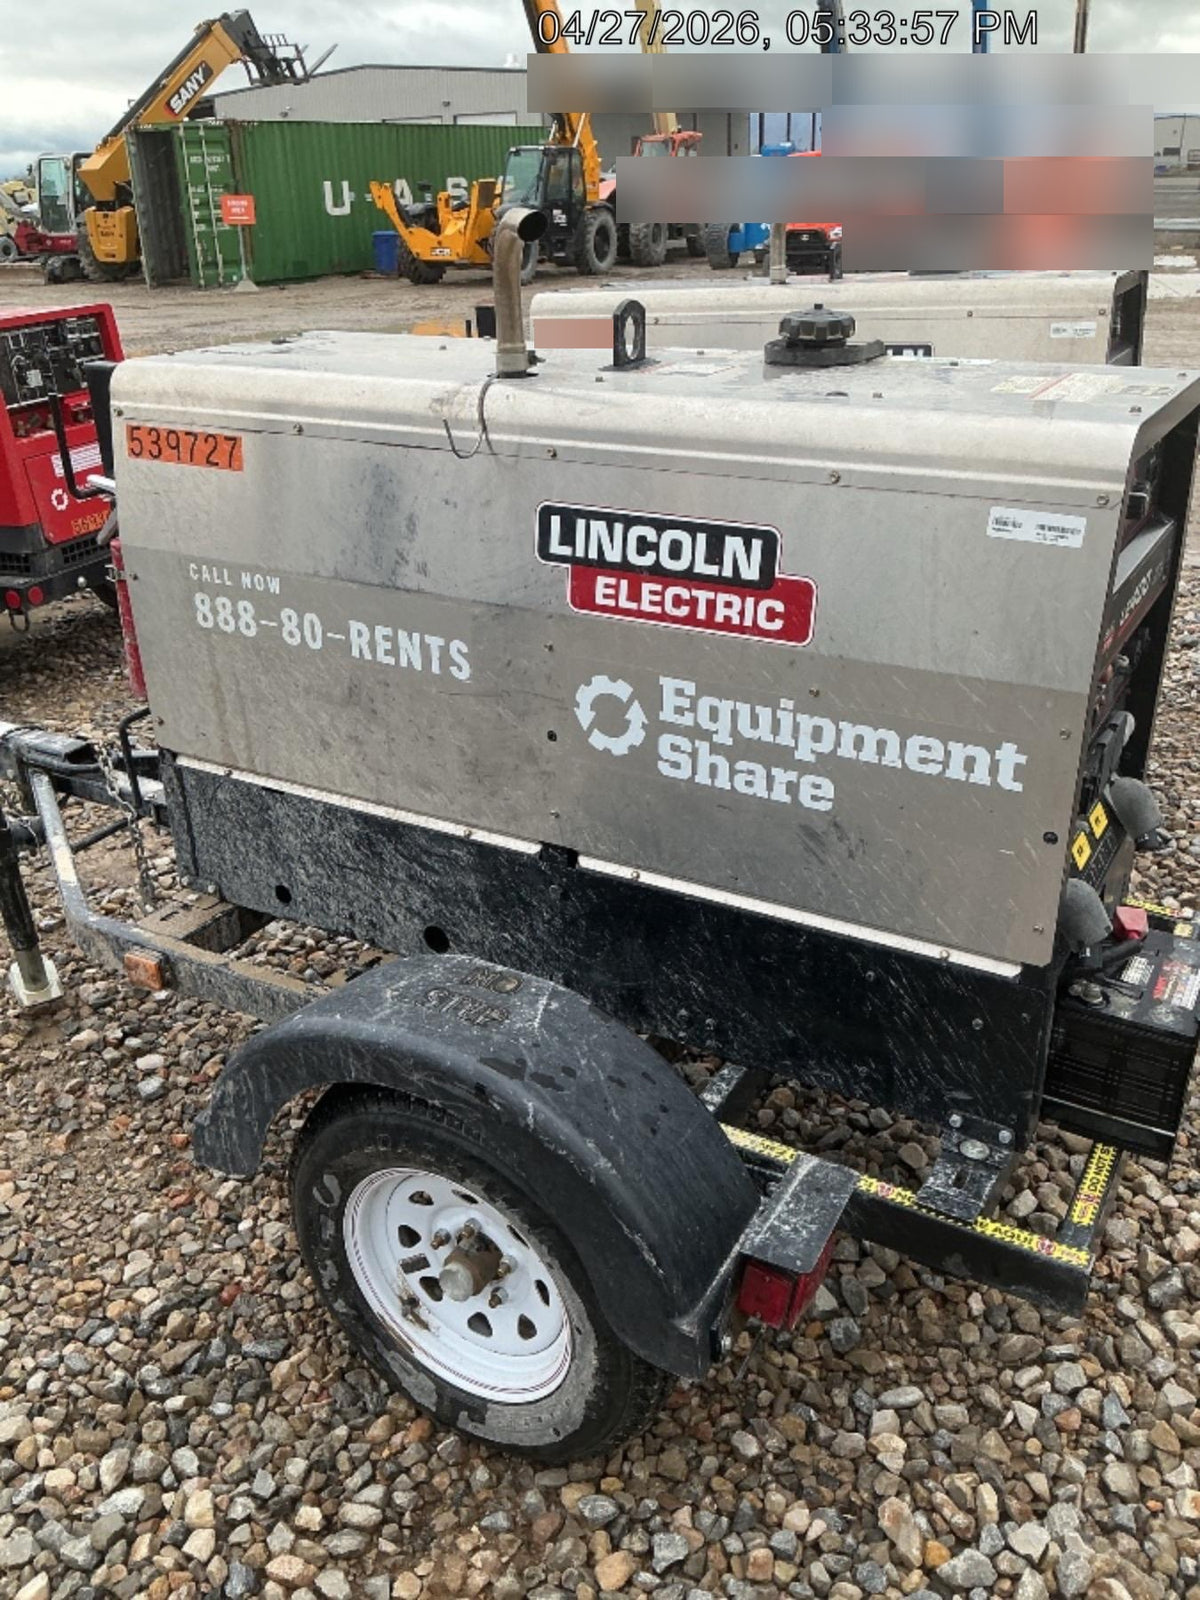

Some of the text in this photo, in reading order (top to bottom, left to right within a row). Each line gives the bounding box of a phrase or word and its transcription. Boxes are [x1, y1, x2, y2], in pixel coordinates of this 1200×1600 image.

[170, 67, 205, 114] SANY
[130, 426, 237, 468] 539727
[189, 563, 280, 594] CALL NOW
[549, 515, 763, 581] LINCOLN
[595, 575, 785, 631] ELECTRIC
[193, 591, 471, 681] 888-80-RENTS
[659, 675, 1028, 793] Equipment
[657, 733, 835, 812] Share
